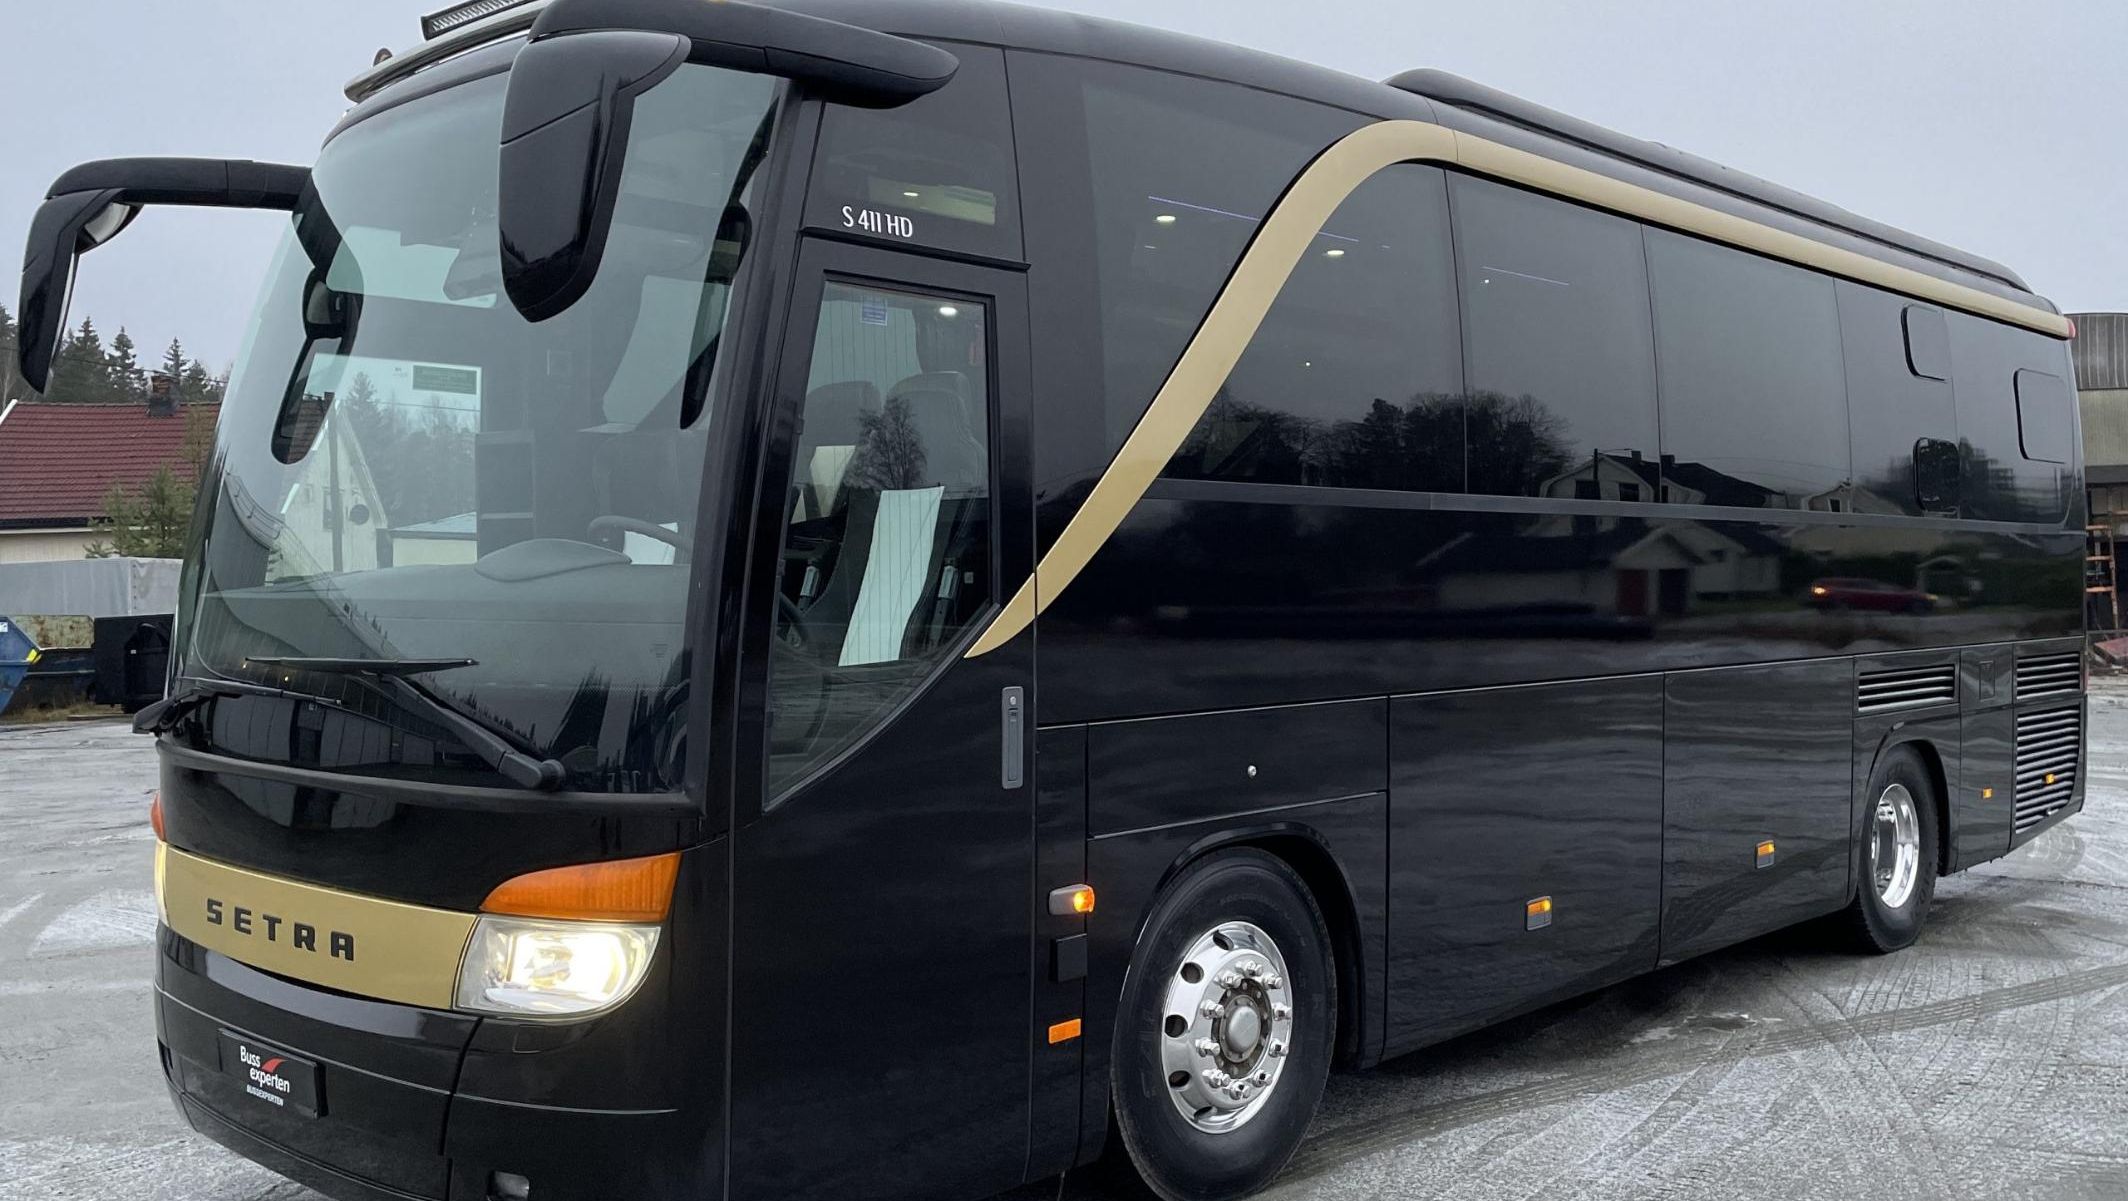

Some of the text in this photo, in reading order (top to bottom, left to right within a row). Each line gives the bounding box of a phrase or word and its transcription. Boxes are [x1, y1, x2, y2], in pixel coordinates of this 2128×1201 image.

[842, 205, 913, 238] S 411 HD
[206, 898, 354, 962] SETRA
[240, 1045, 260, 1068] Buss
[249, 1067, 290, 1093] experten
